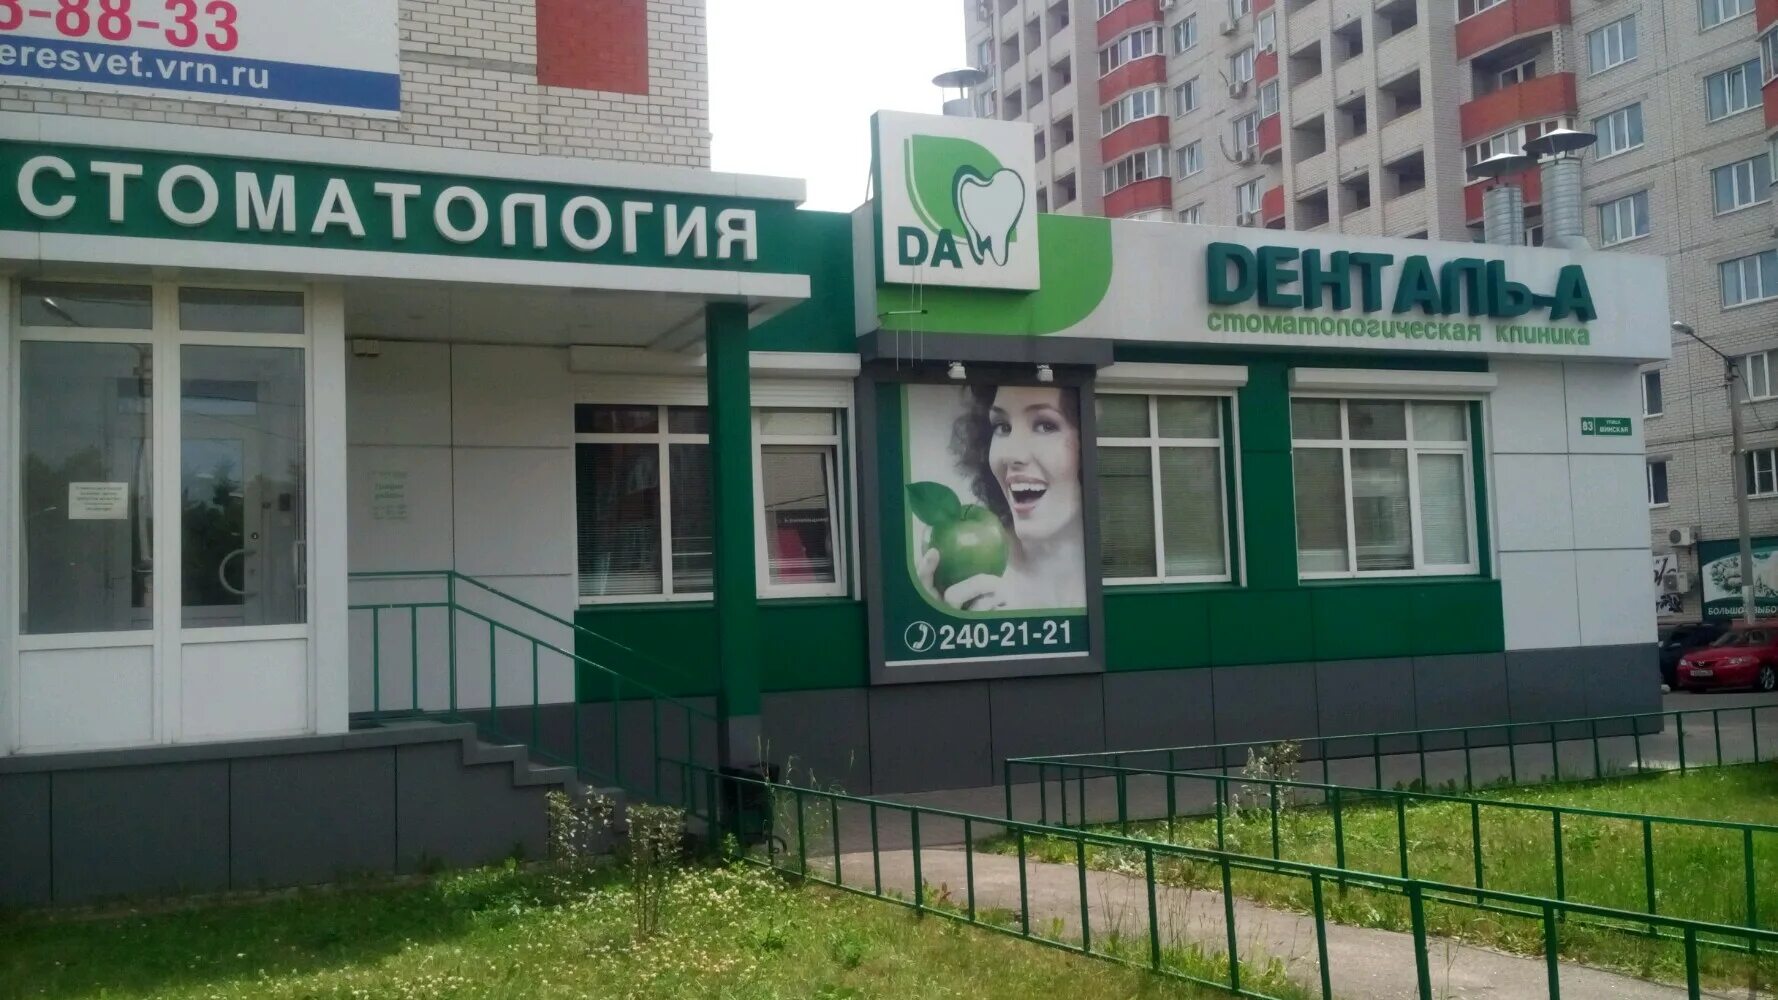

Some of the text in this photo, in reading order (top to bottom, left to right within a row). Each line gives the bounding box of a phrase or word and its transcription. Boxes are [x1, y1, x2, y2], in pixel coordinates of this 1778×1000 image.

[0, 44, 269, 89] eresvet.vrn.ru
[16, 156, 759, 262] СТОМАТОЛОГИЯ
[1207, 310, 1591, 346] стоматологическая клиника
[1708, 607, 1745, 616] БОЛЬШО
[939, 620, 1070, 650] 240-21-21
